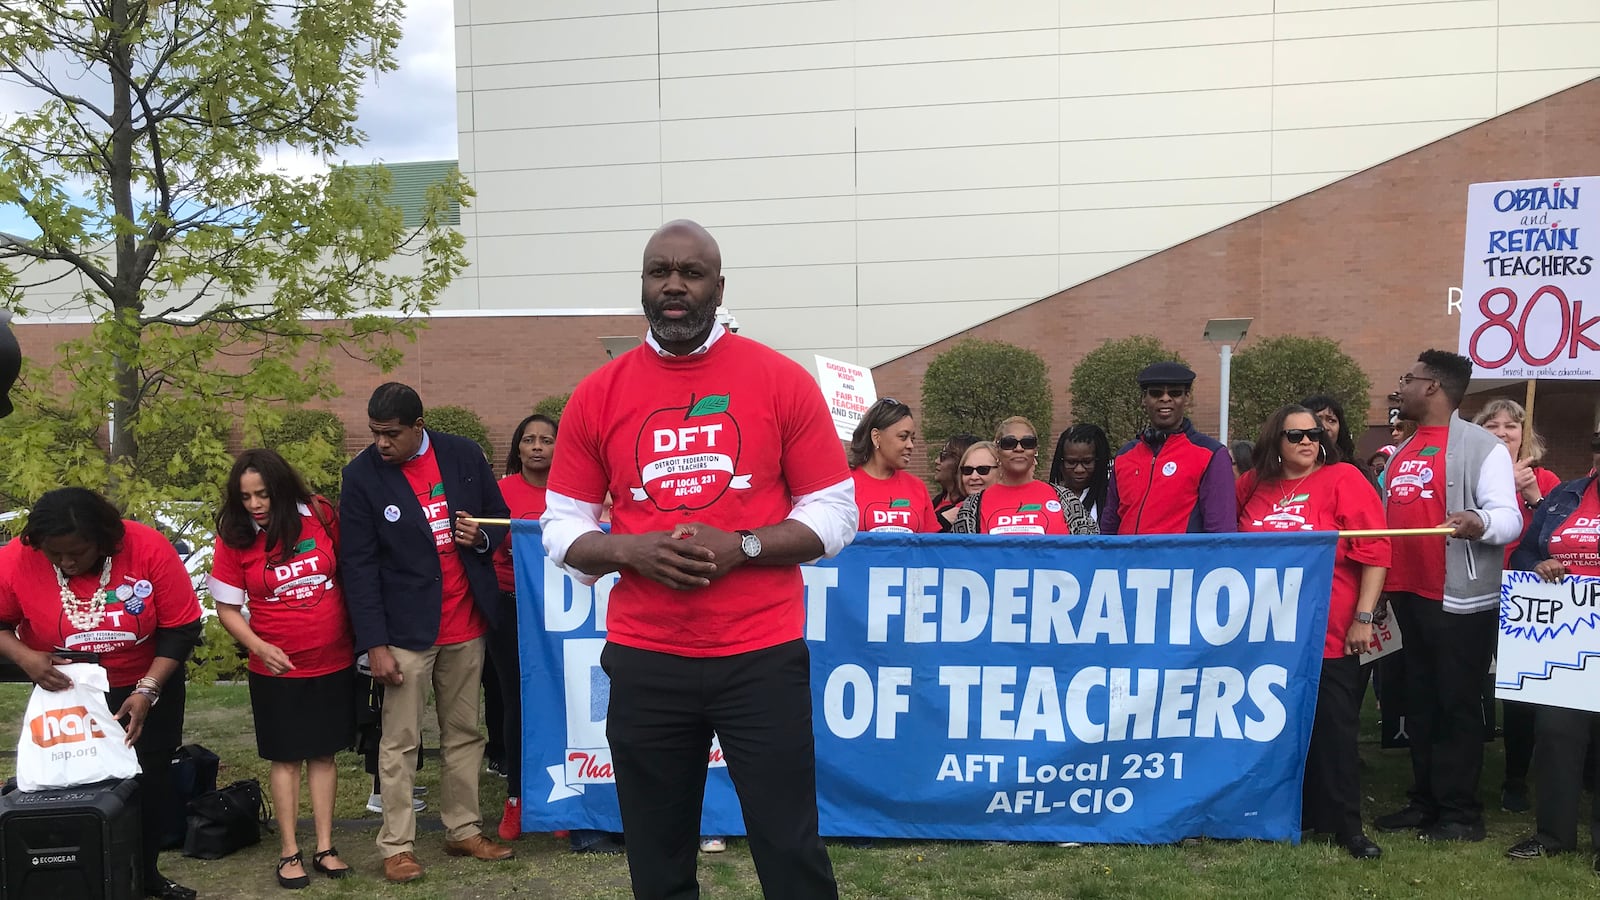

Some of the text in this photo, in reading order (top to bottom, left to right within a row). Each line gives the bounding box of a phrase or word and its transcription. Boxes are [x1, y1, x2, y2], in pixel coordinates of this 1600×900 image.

[1520, 212, 1549, 225] and
[1483, 256, 1594, 277] TEACHERS
[826, 362, 863, 377] GOOD FOR
[837, 372, 855, 382] KIDS
[842, 383, 855, 391] AND
[835, 390, 865, 404] FAIR TO
[831, 398, 870, 413] TEACHERS
[831, 407, 847, 417] AND
[653, 423, 723, 453] DFT
[654, 455, 720, 470] DETROIT FEDERATION
[678, 462, 707, 472] TEACHERS
[1399, 460, 1427, 473] DFT
[660, 474, 716, 489] AFT LOCAL 231
[674, 485, 702, 497] AFL-CIO
[873, 510, 911, 524] DFT
[997, 514, 1039, 526] DFT
[274, 556, 320, 582] DFT
[867, 566, 1304, 646] FEDERATION
[1507, 595, 1564, 624] STEP
[823, 663, 1288, 743] OF TEACHERS
[43, 711, 103, 742] hap
[51, 746, 97, 762] hap.org
[936, 752, 1184, 784] AFT Local 231
[985, 786, 1135, 814] AFL-CIO
[40, 854, 77, 865] ECOXGEAR
